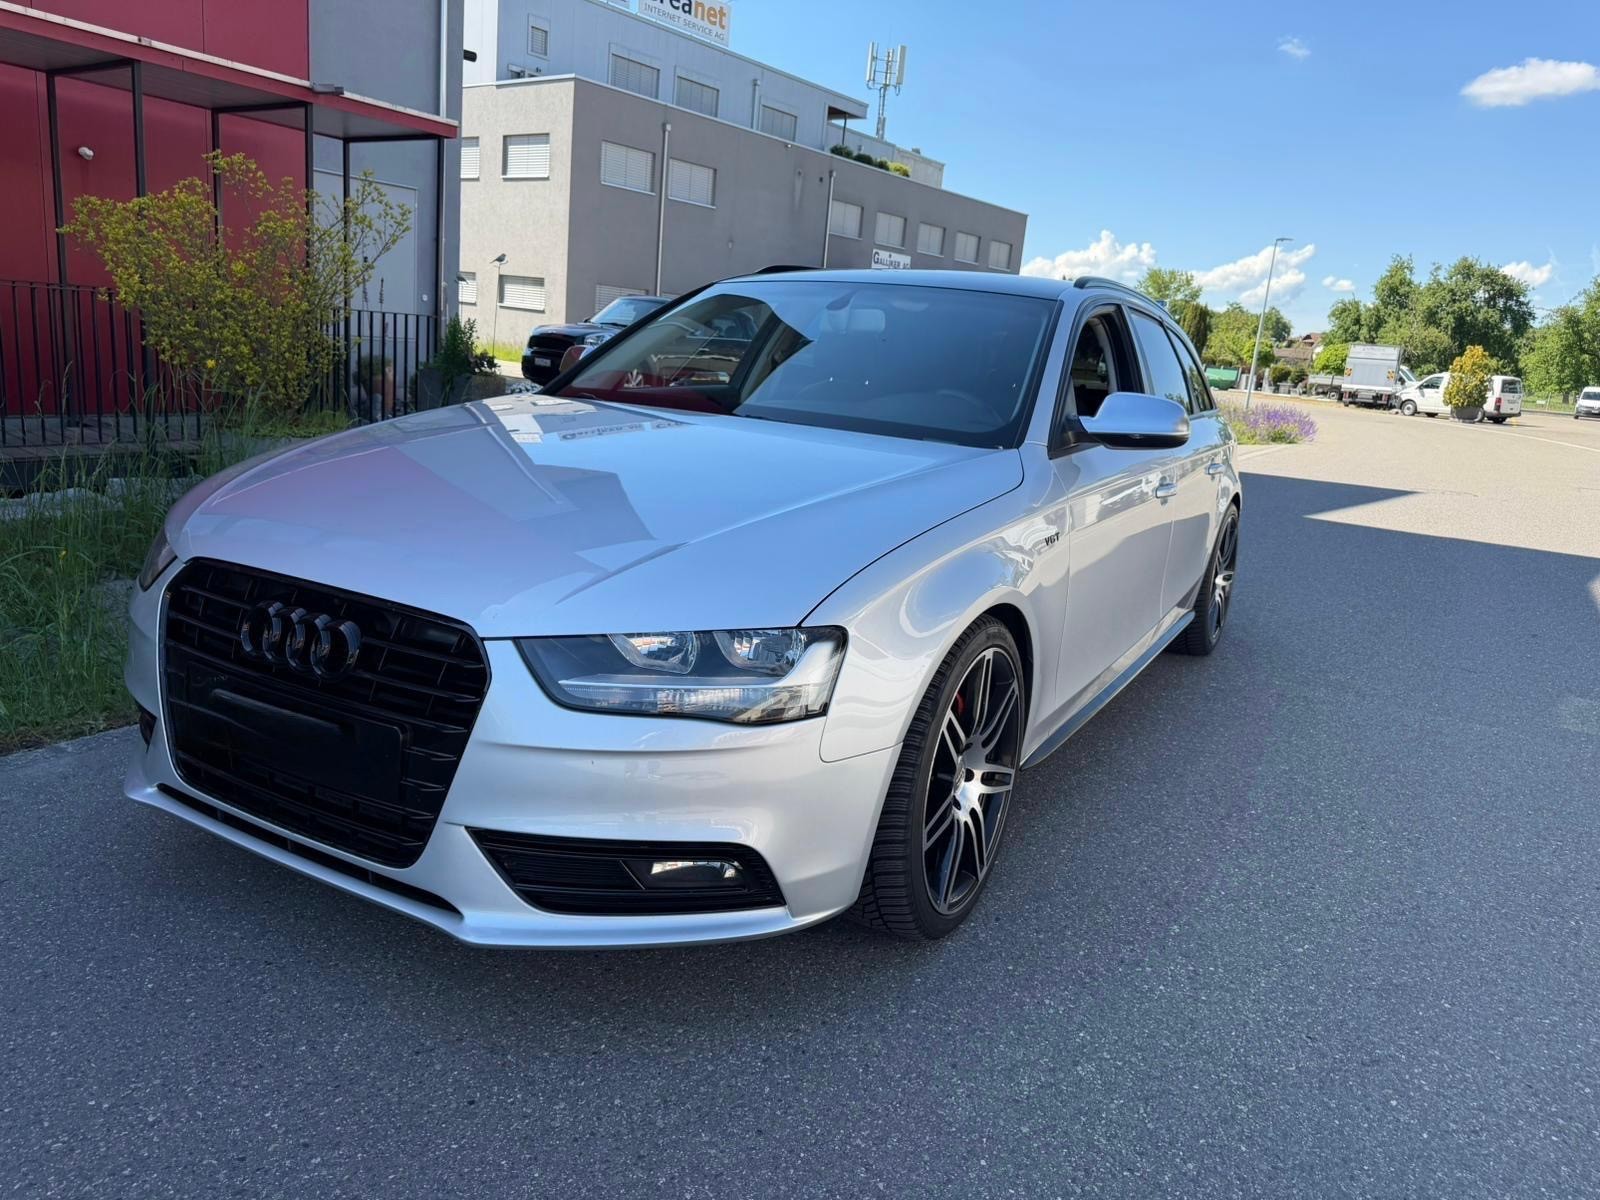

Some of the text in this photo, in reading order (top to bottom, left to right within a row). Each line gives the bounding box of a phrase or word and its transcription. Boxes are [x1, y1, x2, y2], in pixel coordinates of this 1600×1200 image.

[644, 3, 725, 41] INTERNET SERVICE AG
[651, 0, 727, 30] eanet
